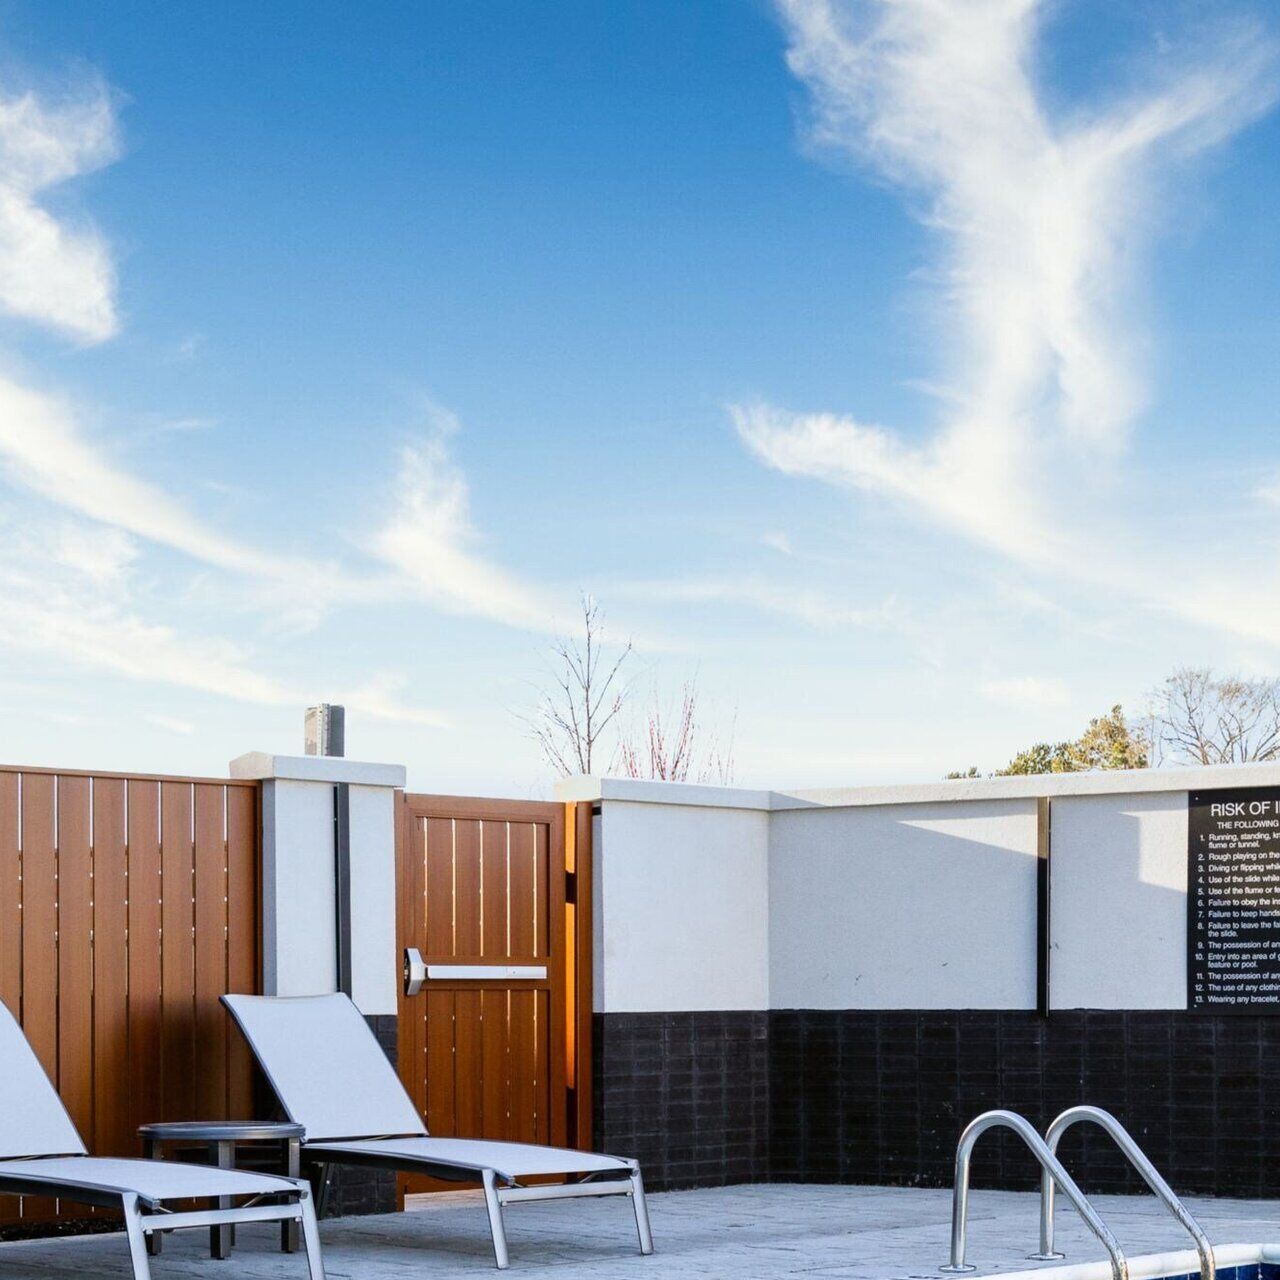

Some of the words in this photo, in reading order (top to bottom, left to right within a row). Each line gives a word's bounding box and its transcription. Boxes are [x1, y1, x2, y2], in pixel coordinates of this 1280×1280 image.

[1211, 802, 1245, 816] RISK
[1249, 801, 1271, 814] OF
[1217, 821, 1232, 829] THE
[1233, 819, 1279, 828] FOLLOWING
